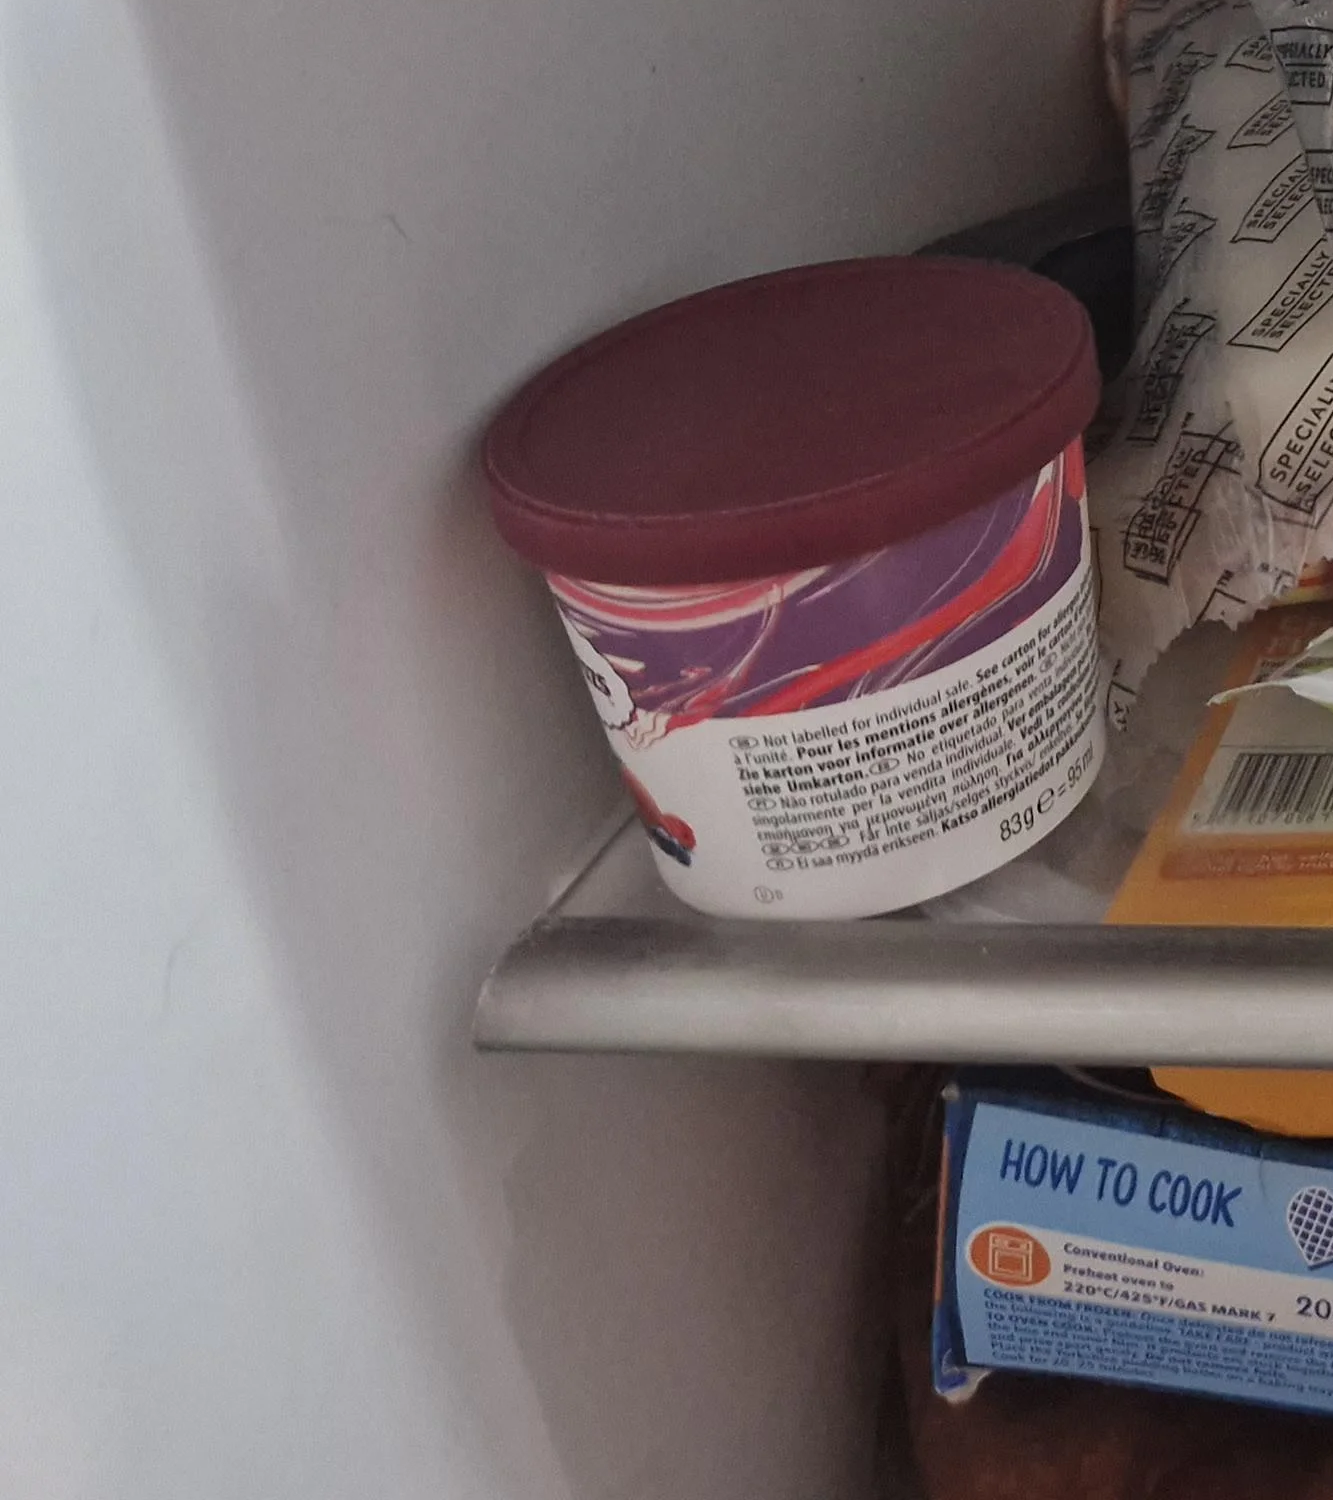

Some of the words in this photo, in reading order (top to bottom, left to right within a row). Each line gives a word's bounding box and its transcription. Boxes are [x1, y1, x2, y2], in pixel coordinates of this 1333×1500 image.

[1252, 251, 1330, 338] SPECIALLY
[763, 734, 788, 749] Not
[791, 721, 849, 745] labelled
[851, 716, 872, 732] for
[875, 688, 942, 726] individual
[975, 663, 1000, 684] See
[1001, 636, 1037, 669] carton
[1037, 624, 1052, 643] for
[796, 742, 833, 760] Pour
[837, 737, 861, 753] les
[864, 710, 938, 744] mentions
[1014, 656, 1036, 677] voir
[737, 767, 760, 782] Zie
[762, 760, 814, 780] karton
[817, 755, 852, 773] voor
[855, 728, 937, 765] informatie
[938, 714, 969, 736] over
[742, 783, 782, 797] siehe
[786, 769, 870, 794] Umkarton.
[906, 748, 926, 765] No
[931, 715, 998, 756] etiquetado
[1001, 698, 1025, 725] para
[751, 803, 847, 828] singolarmente
[851, 799, 875, 817] per
[879, 792, 893, 806] la
[897, 774, 946, 802] vendita
[1020, 717, 1044, 740] Vedi
[810, 784, 868, 807] rotulado
[870, 775, 901, 797] para
[902, 759, 944, 783] venda
[1006, 712, 1028, 733] Ver
[885, 820, 912, 838] inte
[940, 807, 979, 834] Katso
[998, 804, 1036, 843] 83g
[999, 1138, 1086, 1196] HOW
[1097, 1156, 1139, 1208] TO
[1149, 1168, 1243, 1228] COOK
[1062, 1241, 1160, 1271] Conventional
[1062, 1263, 1119, 1284] Preheat
[1120, 1274, 1157, 1289] oven
[1159, 1279, 1176, 1292] to
[1210, 1304, 1262, 1323] MARK
[1265, 1312, 1277, 1323] 7
